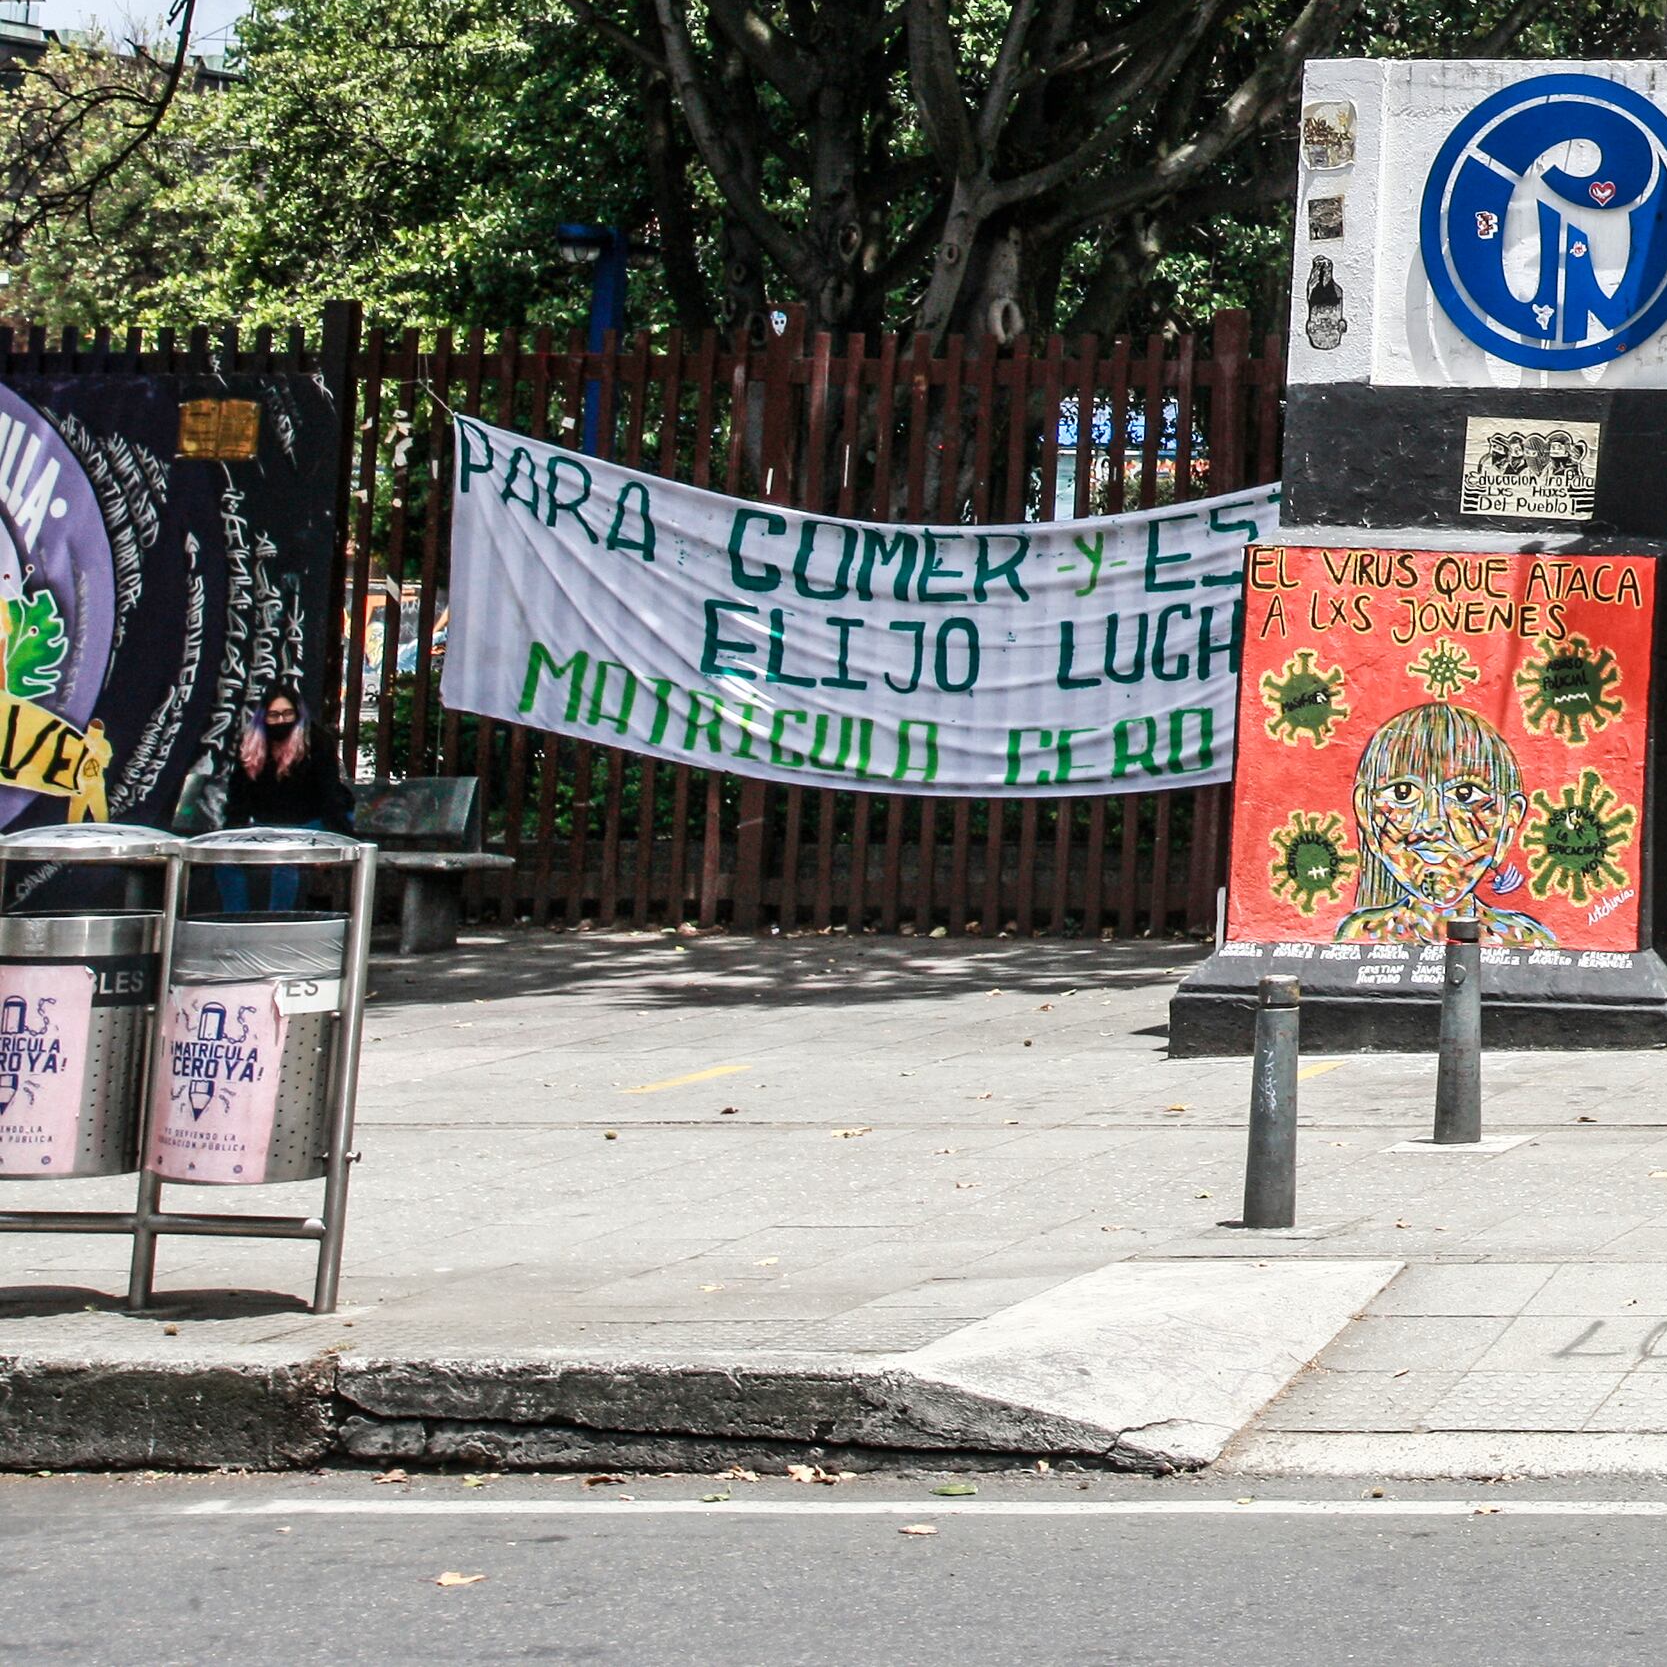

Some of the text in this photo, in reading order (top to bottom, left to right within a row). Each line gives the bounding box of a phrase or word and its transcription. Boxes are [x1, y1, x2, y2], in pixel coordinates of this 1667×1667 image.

[458, 417, 657, 562] PARA
[729, 510, 1029, 606] COMER
[1480, 496, 1506, 512] Del
[1250, 547, 1643, 609] EL VIRUS QUE ATACA
[701, 599, 981, 694] ELIJO
[1259, 593, 1288, 639] A
[1391, 597, 1569, 645] JOVENES
[1004, 707, 1215, 786] CERO
[172, 1056, 219, 1079] CERO
